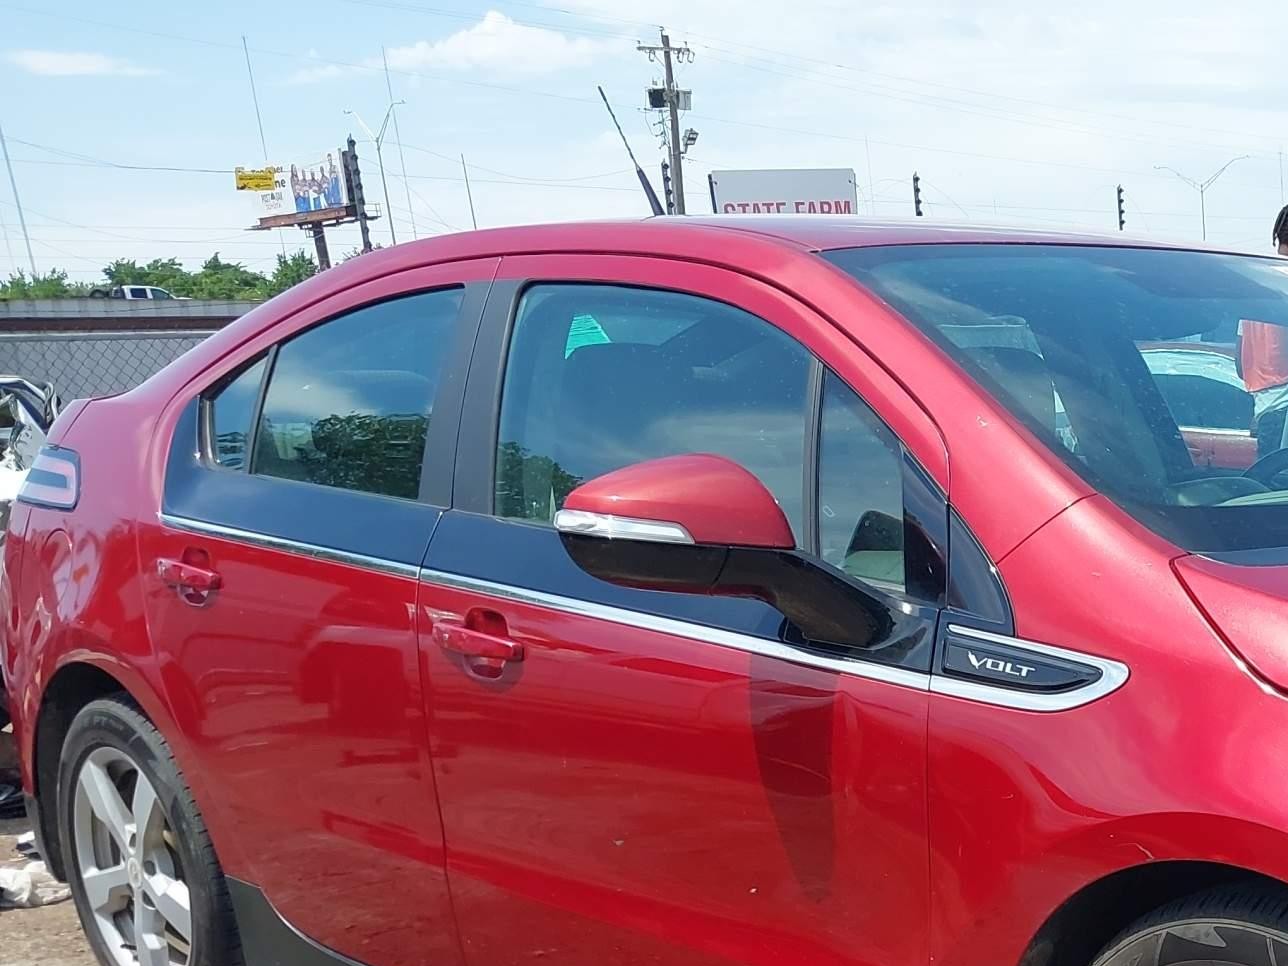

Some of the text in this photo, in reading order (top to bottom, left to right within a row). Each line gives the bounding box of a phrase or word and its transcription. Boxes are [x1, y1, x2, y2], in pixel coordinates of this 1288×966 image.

[723, 200, 851, 214] STATE FARM
[967, 650, 1036, 677] VOLT
